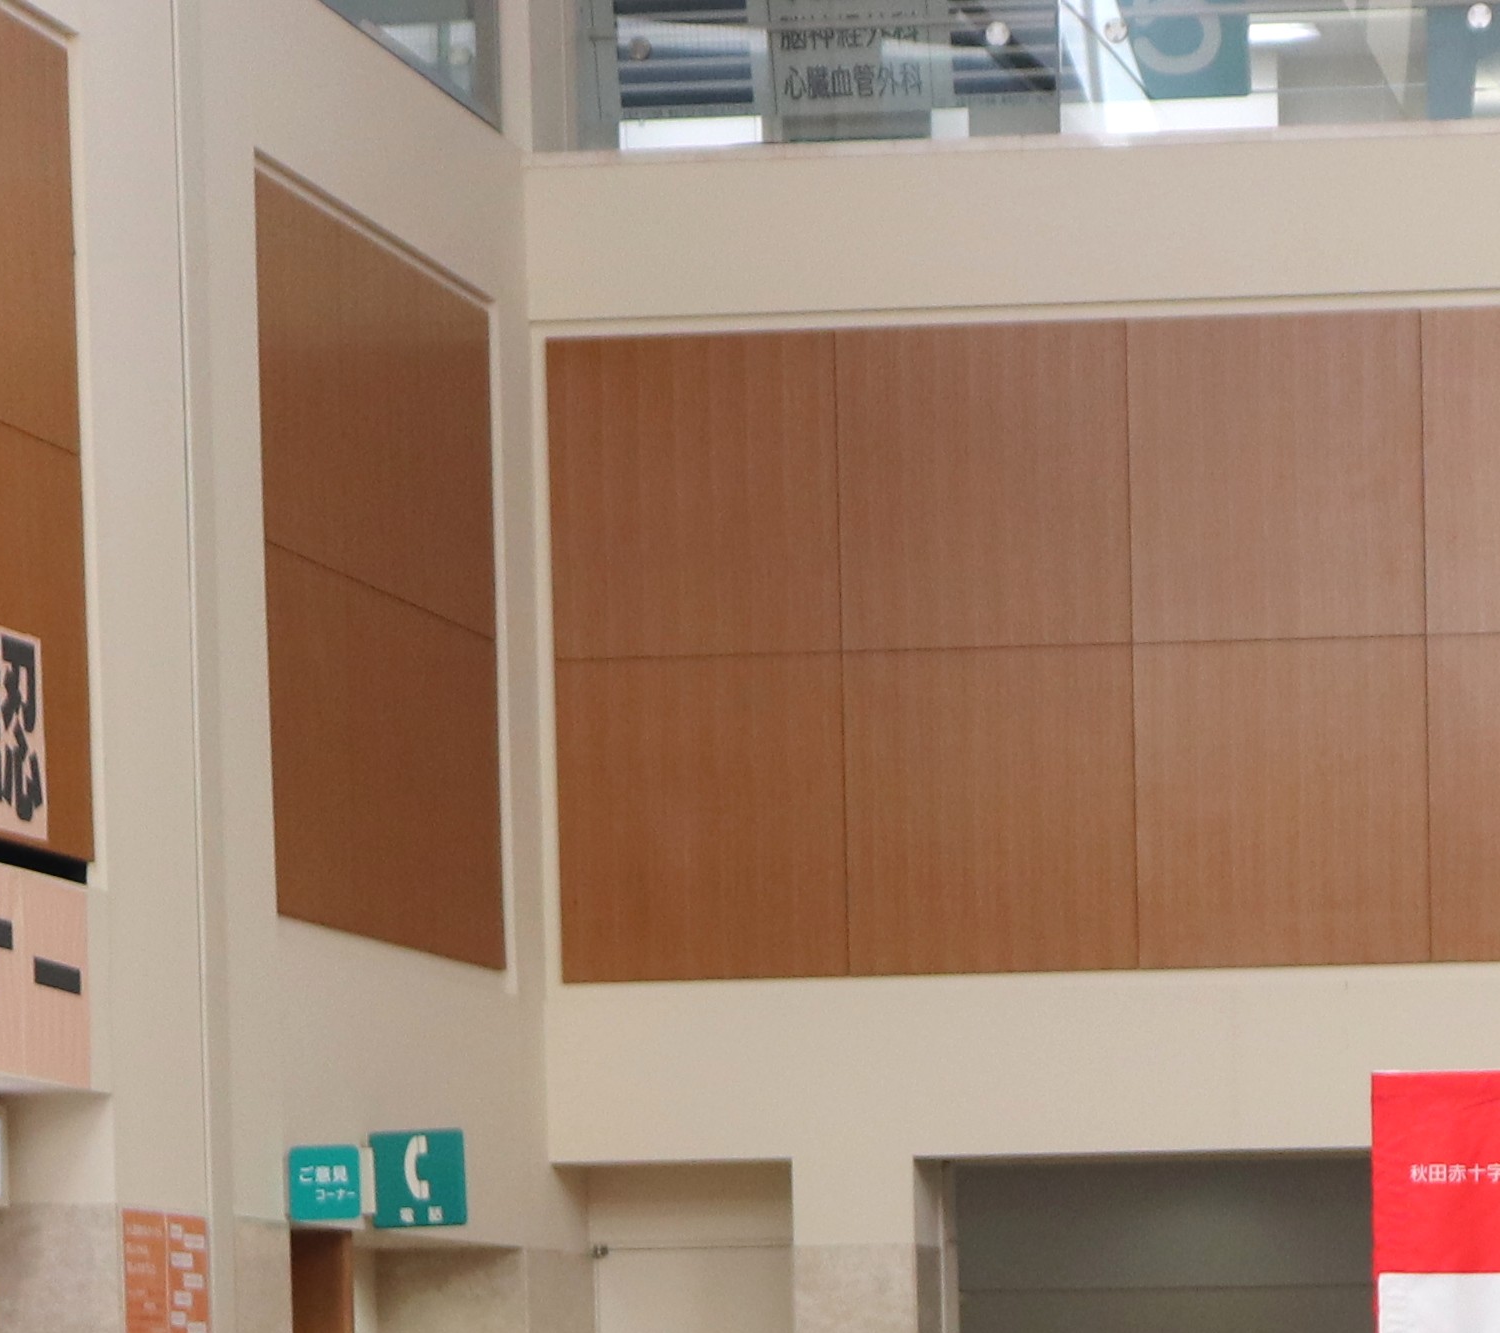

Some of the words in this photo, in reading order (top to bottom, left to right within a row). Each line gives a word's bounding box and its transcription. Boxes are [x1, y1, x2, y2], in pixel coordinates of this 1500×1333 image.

[299, 1164, 348, 1184] ご意見
[315, 1187, 355, 1201] コーナー
